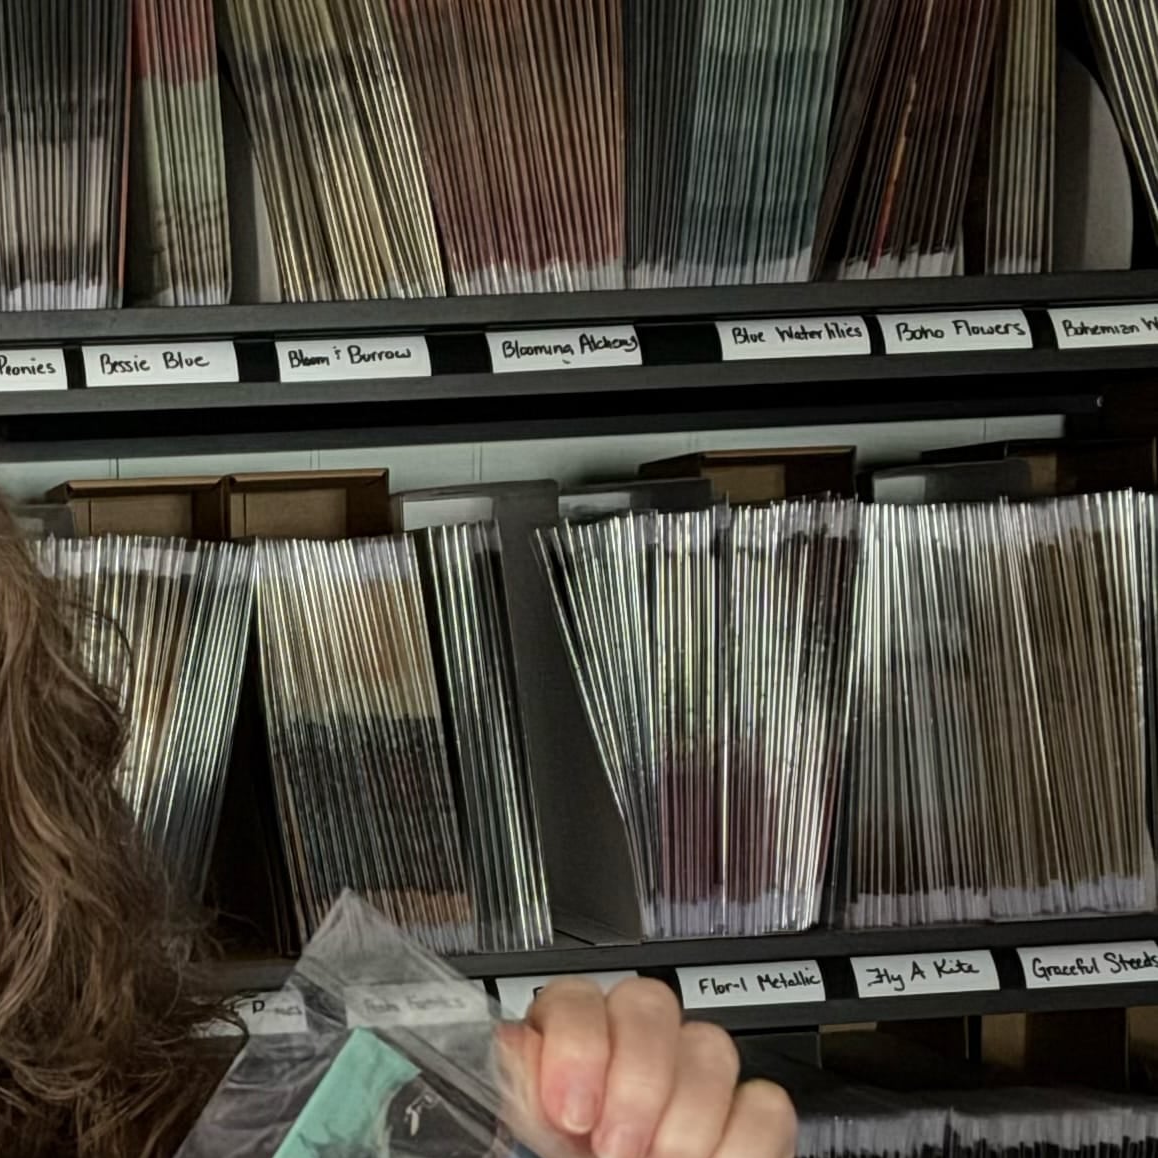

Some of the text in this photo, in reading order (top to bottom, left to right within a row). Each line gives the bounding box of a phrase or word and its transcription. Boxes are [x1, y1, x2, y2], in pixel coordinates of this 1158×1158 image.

[731, 327, 766, 345] Blue
[895, 320, 1026, 342] Boho Flowers
[1061, 319, 1140, 338] Bohemian
[99, 350, 211, 376] Bessie Blue
[347, 344, 413, 366] Burrow
[910, 961, 927, 982] A
[936, 956, 980, 977] Kite
[1031, 955, 1100, 980] Graceful
[756, 967, 821, 993] Metallic
